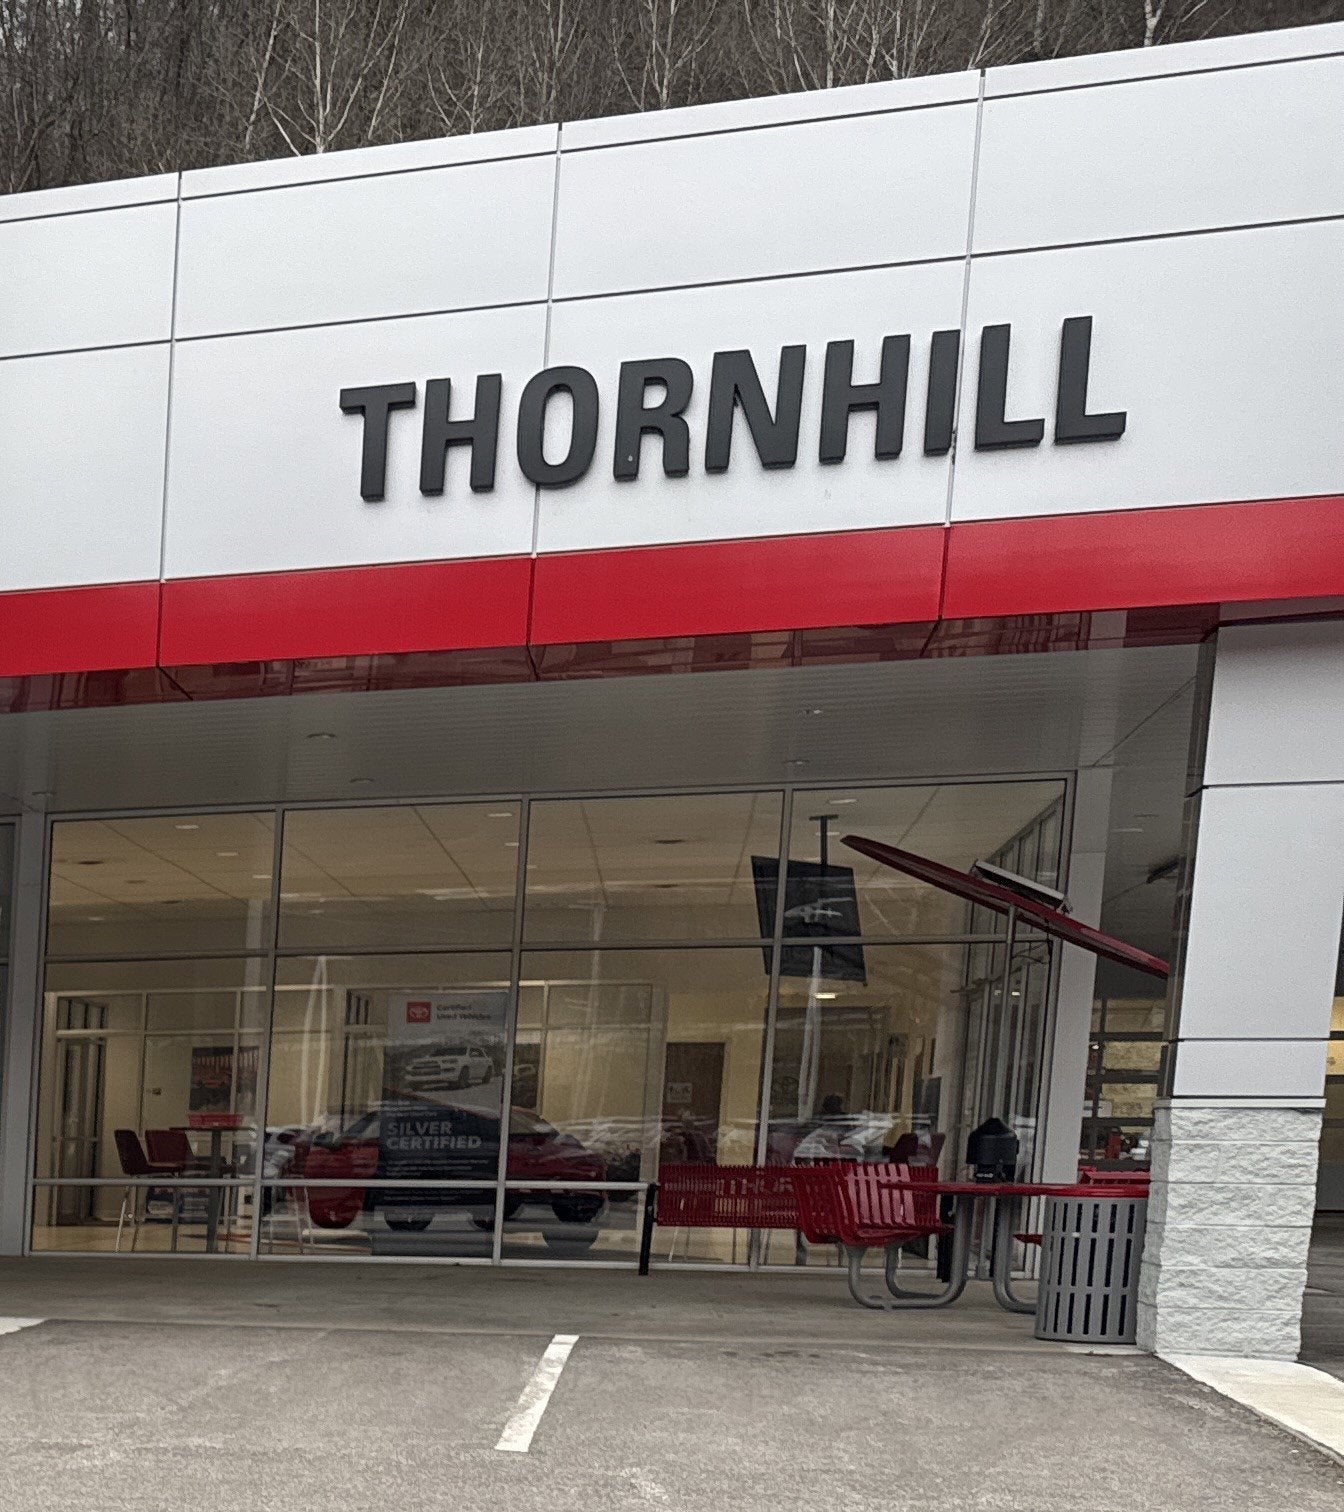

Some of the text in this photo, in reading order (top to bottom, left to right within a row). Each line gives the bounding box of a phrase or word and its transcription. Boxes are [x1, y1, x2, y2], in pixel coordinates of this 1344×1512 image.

[340, 316, 1127, 502] THORNHILL
[386, 1120, 452, 1136] SILVER
[385, 1134, 482, 1150] CERTIFIED
